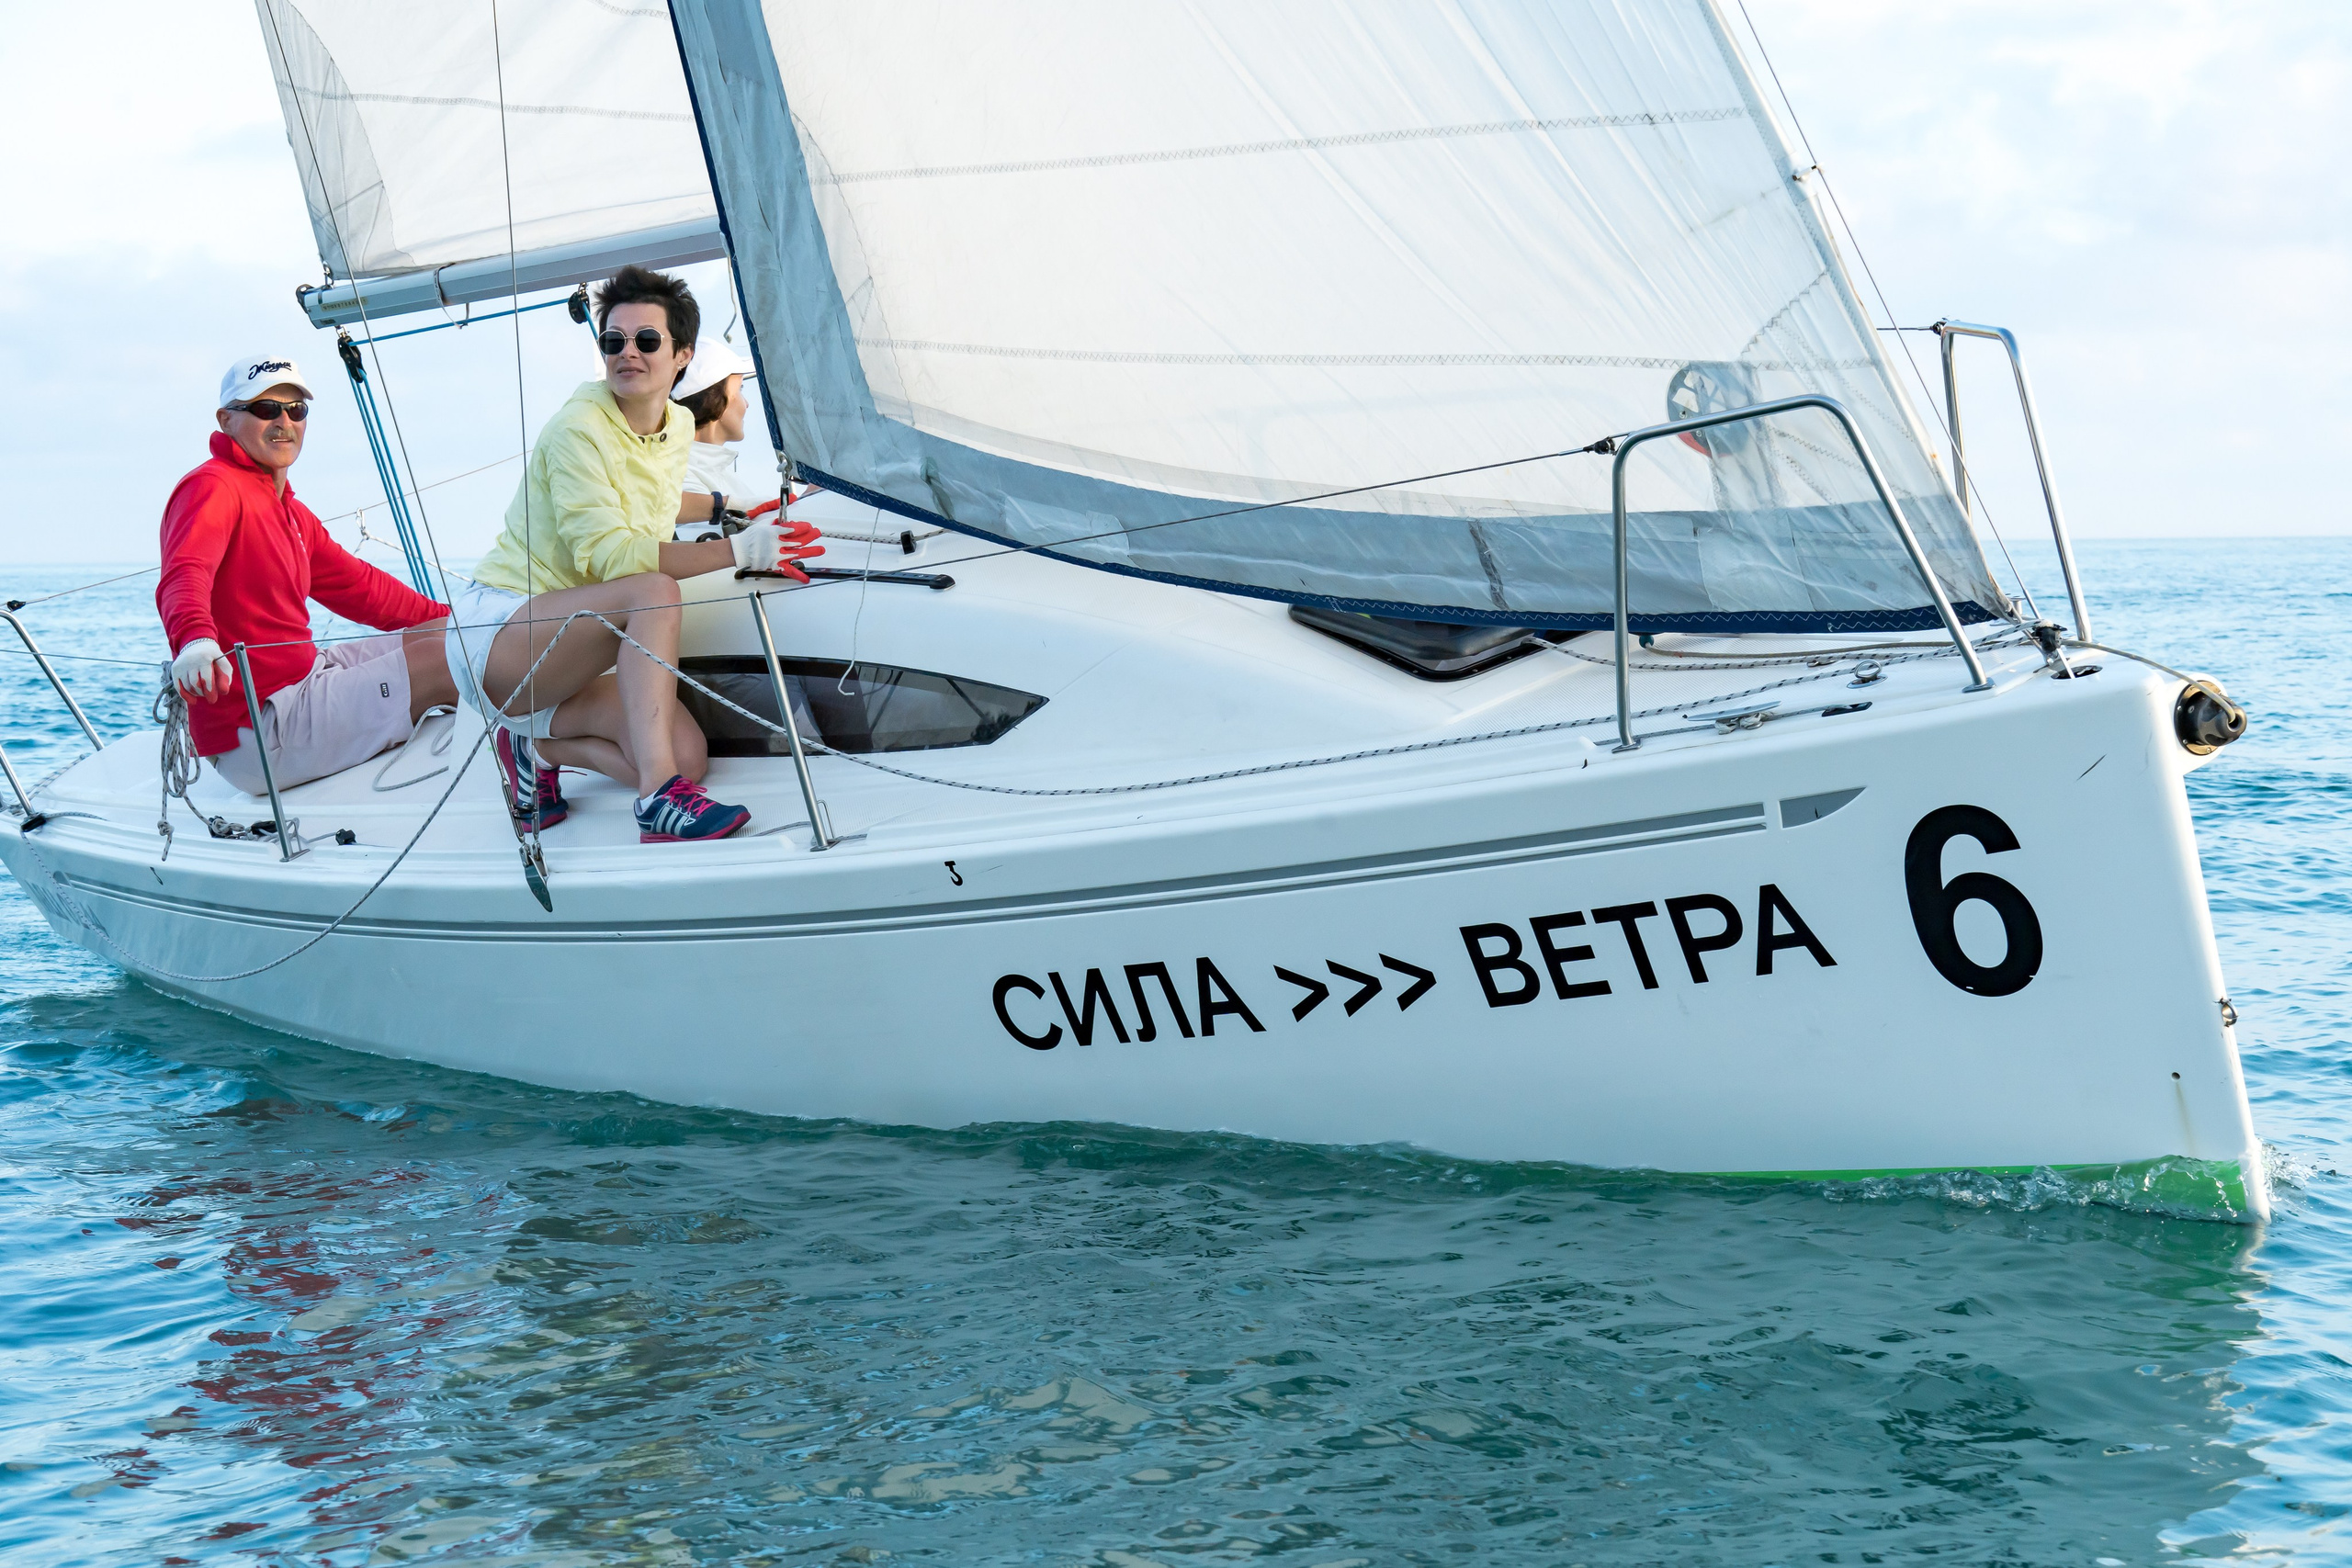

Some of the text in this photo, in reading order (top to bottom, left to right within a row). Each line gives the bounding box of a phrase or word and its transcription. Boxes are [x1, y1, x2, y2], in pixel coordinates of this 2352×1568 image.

[993, 883, 1838, 1051] СИЛА ВЕТРА
[1904, 804, 2043, 998] 6
